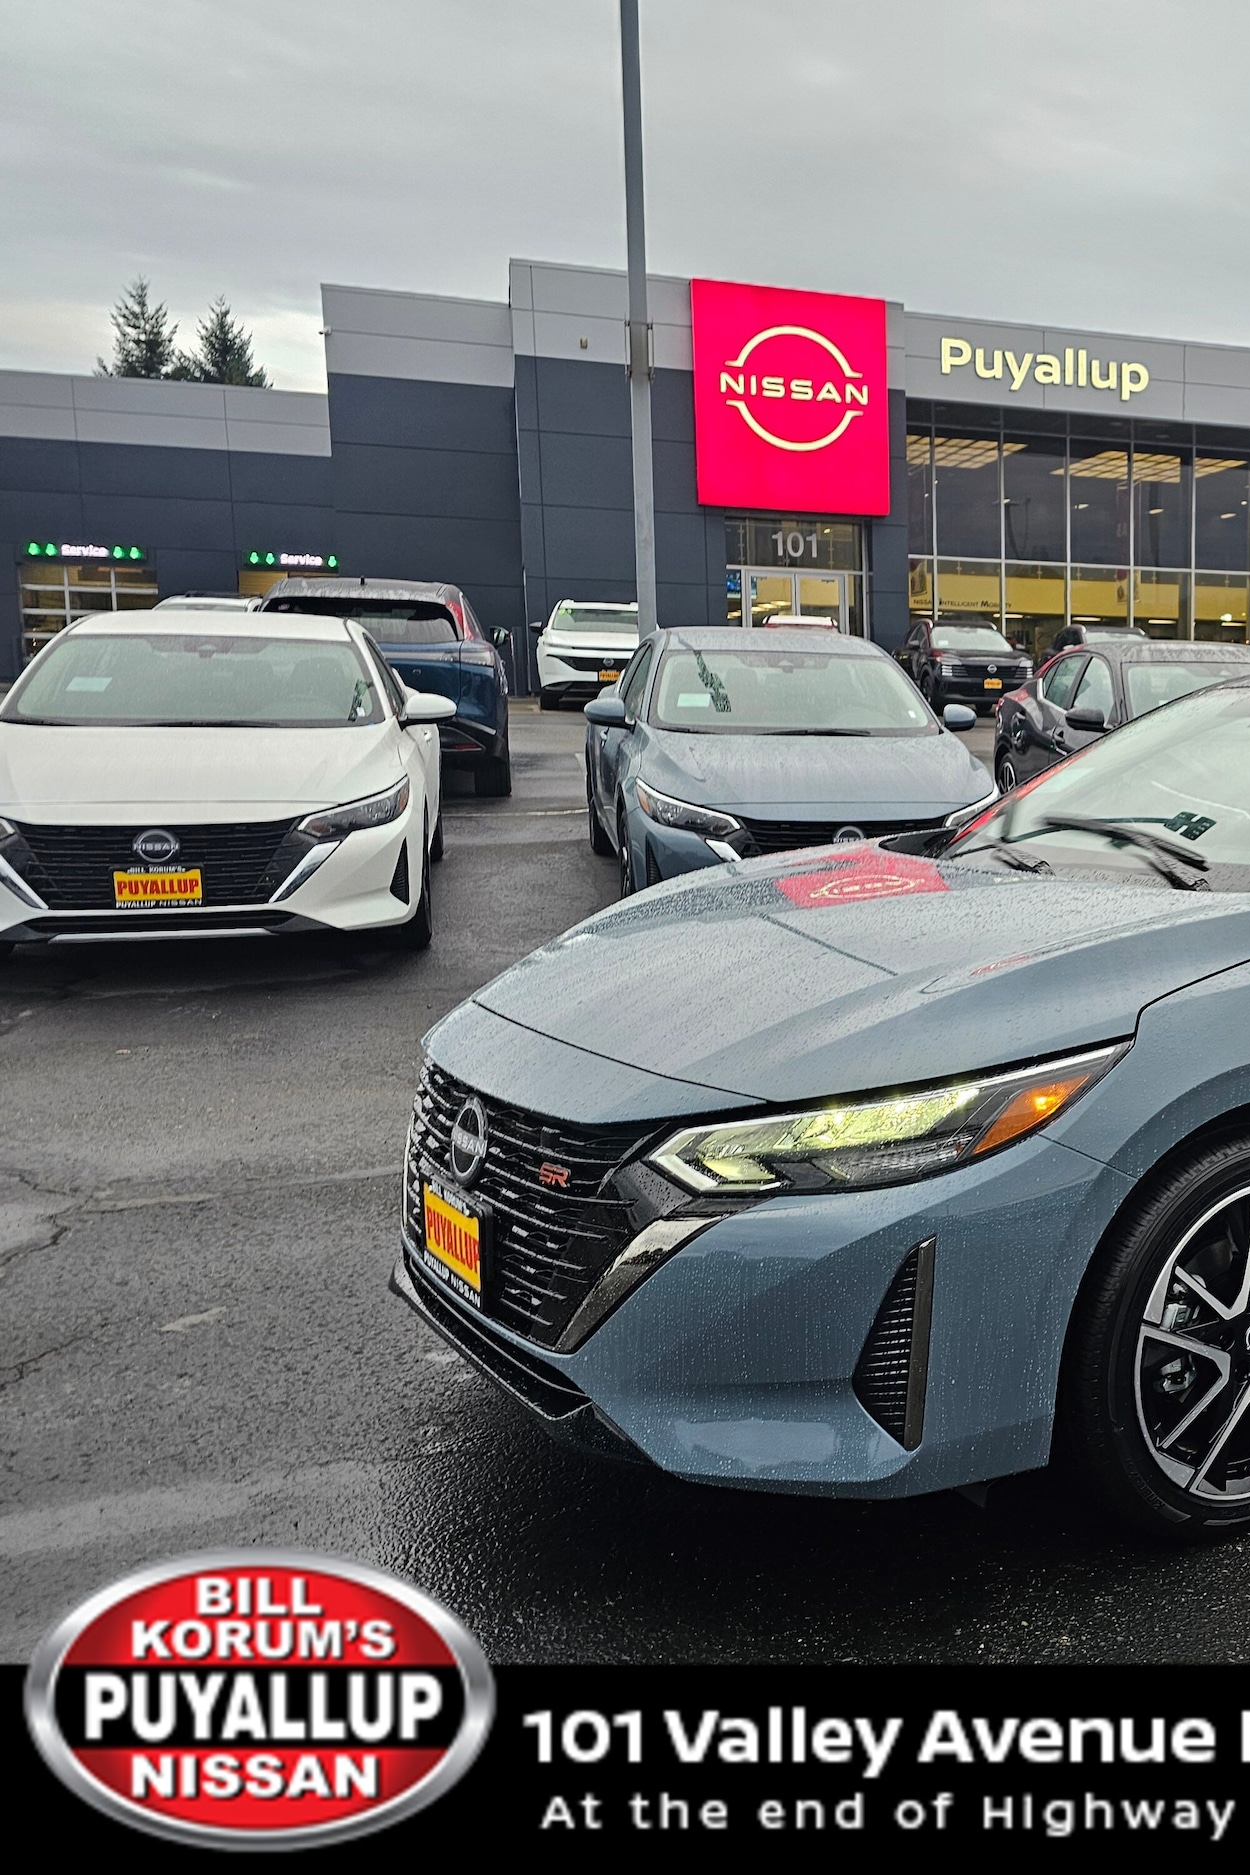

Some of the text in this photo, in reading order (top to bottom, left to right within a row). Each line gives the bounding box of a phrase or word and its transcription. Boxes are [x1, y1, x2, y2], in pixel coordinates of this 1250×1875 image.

[940, 337, 1149, 400] Puyallup
[720, 372, 869, 406] NISSAN
[61, 543, 109, 557] Service
[771, 531, 818, 558] 101
[280, 553, 323, 566] Service
[133, 842, 179, 851] NISSAN
[116, 878, 199, 896] PUYALLUP
[116, 898, 202, 909] PUYALLUP NISSAN
[539, 1162, 571, 1188] SR
[426, 1205, 479, 1274] PUYALLUP
[450, 1273, 481, 1308] NISSAN
